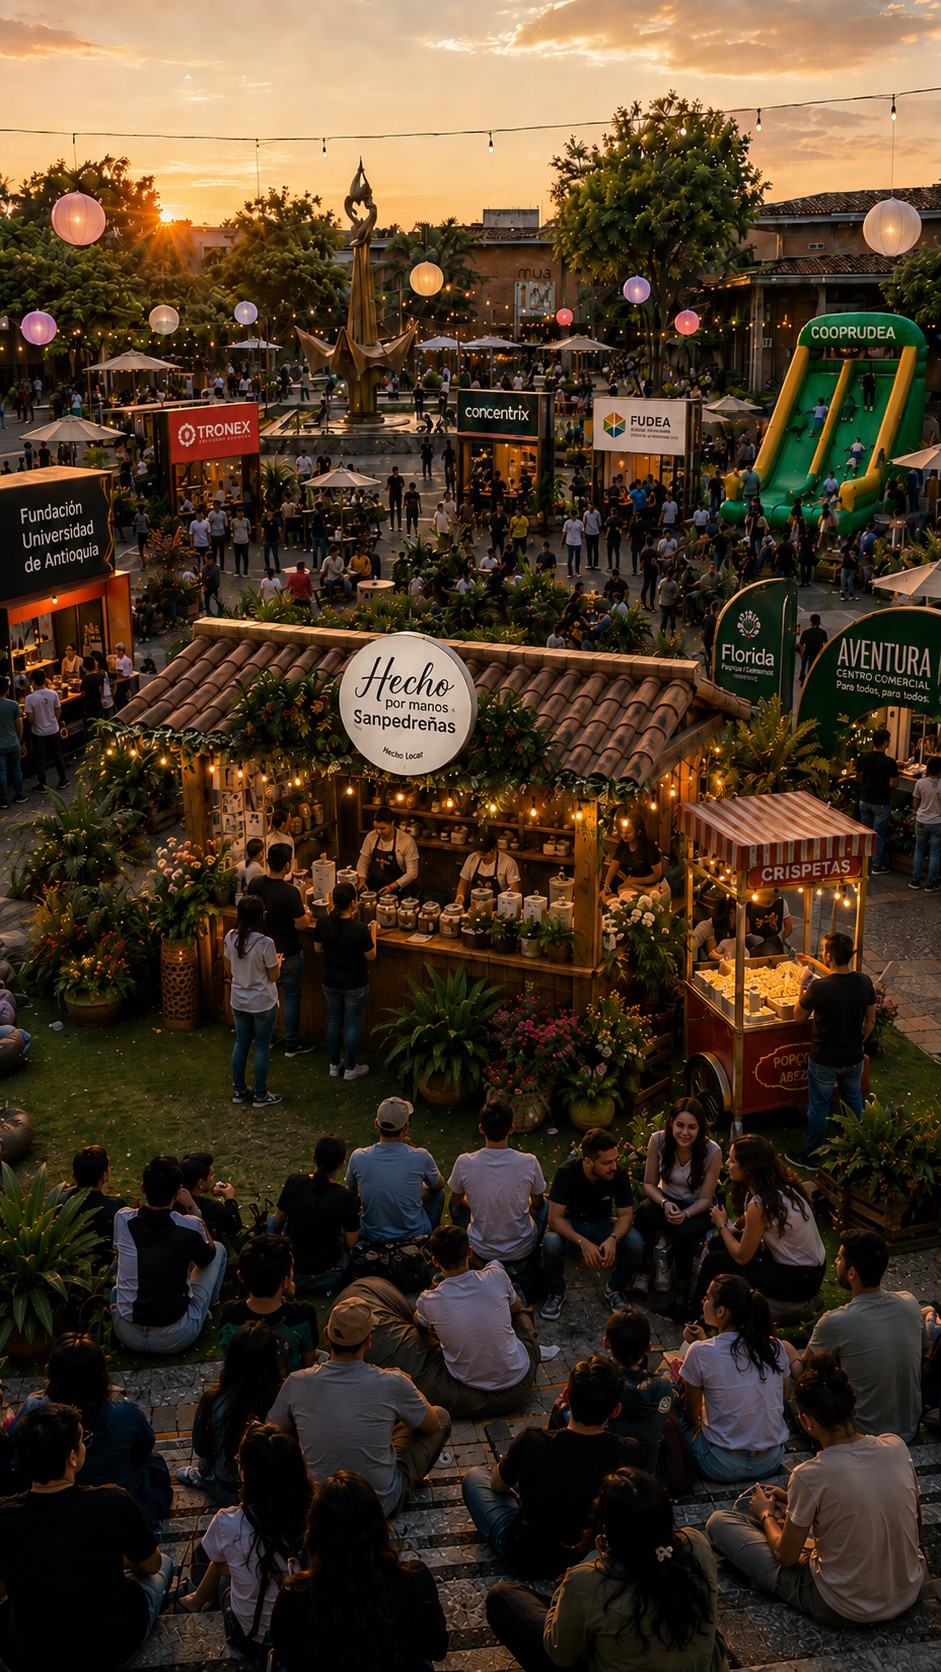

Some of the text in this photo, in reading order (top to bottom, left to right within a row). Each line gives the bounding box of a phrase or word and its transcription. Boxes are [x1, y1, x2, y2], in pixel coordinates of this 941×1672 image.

[811, 326, 896, 340] COOPRUDEA
[465, 404, 530, 421] concentrix
[630, 415, 671, 428] FUDEA
[197, 420, 251, 439] TRONEX
[20, 500, 83, 524] Fundación
[22, 520, 94, 549] Universidad
[24, 542, 99, 573] de Antioquia
[721, 643, 775, 667] Florida
[837, 637, 932, 678] AVENTURA
[354, 656, 455, 702] Hecho
[836, 668, 931, 691] CENTRO COMERCIAL
[836, 680, 855, 691] Para
[856, 684, 881, 697] todos,
[385, 699, 449, 713] por manos
[353, 709, 456, 734] Sanpedreñas
[382, 746, 404, 760] Hecho
[761, 859, 851, 882] CRISPETAS
